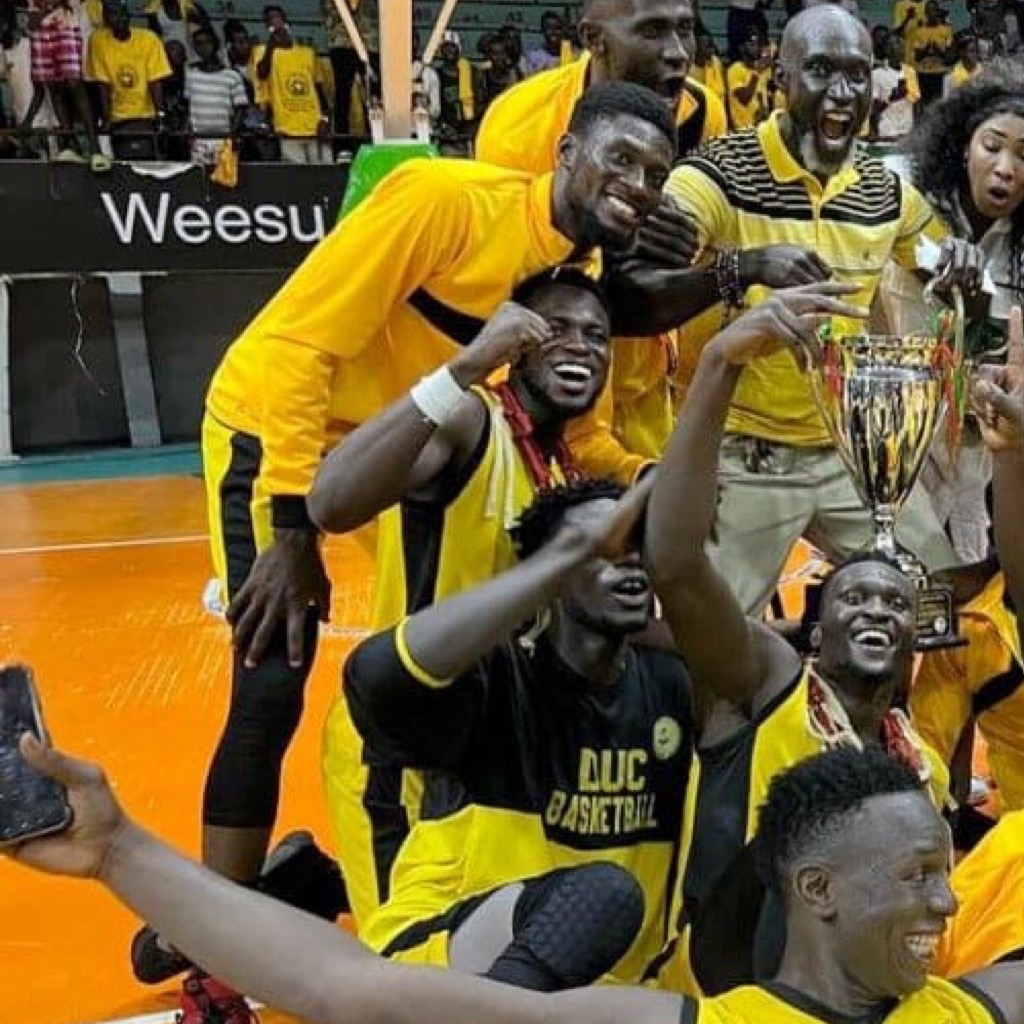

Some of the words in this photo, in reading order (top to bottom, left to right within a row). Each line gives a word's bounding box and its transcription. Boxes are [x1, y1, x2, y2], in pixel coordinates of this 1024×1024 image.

[101, 192, 325, 243] Weesu
[578, 748, 648, 792] DUC
[546, 790, 657, 835] BASKETBALL
